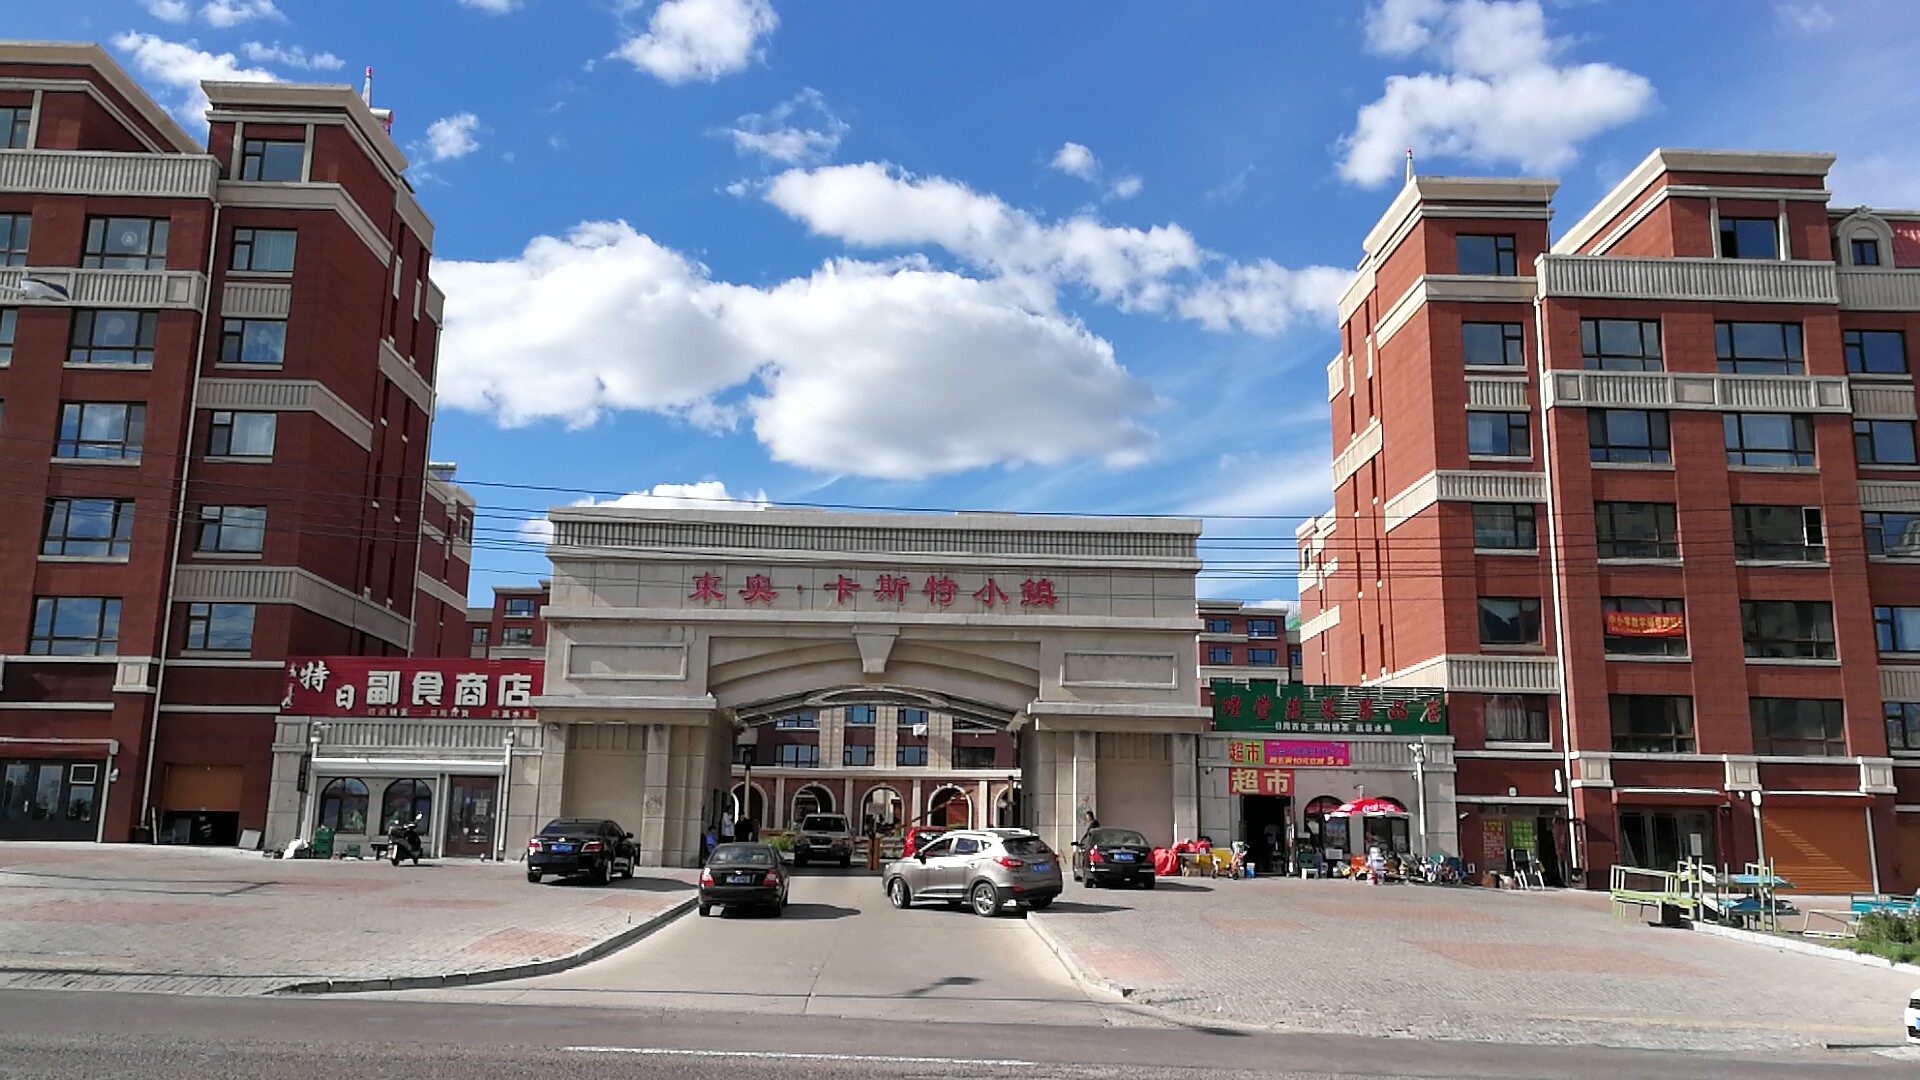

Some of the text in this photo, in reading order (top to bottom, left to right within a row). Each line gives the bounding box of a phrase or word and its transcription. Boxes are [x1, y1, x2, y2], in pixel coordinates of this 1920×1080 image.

[366, 670, 533, 708] 副食商店
[1229, 740, 1261, 764] 超市
[1231, 768, 1291, 795] 超市
